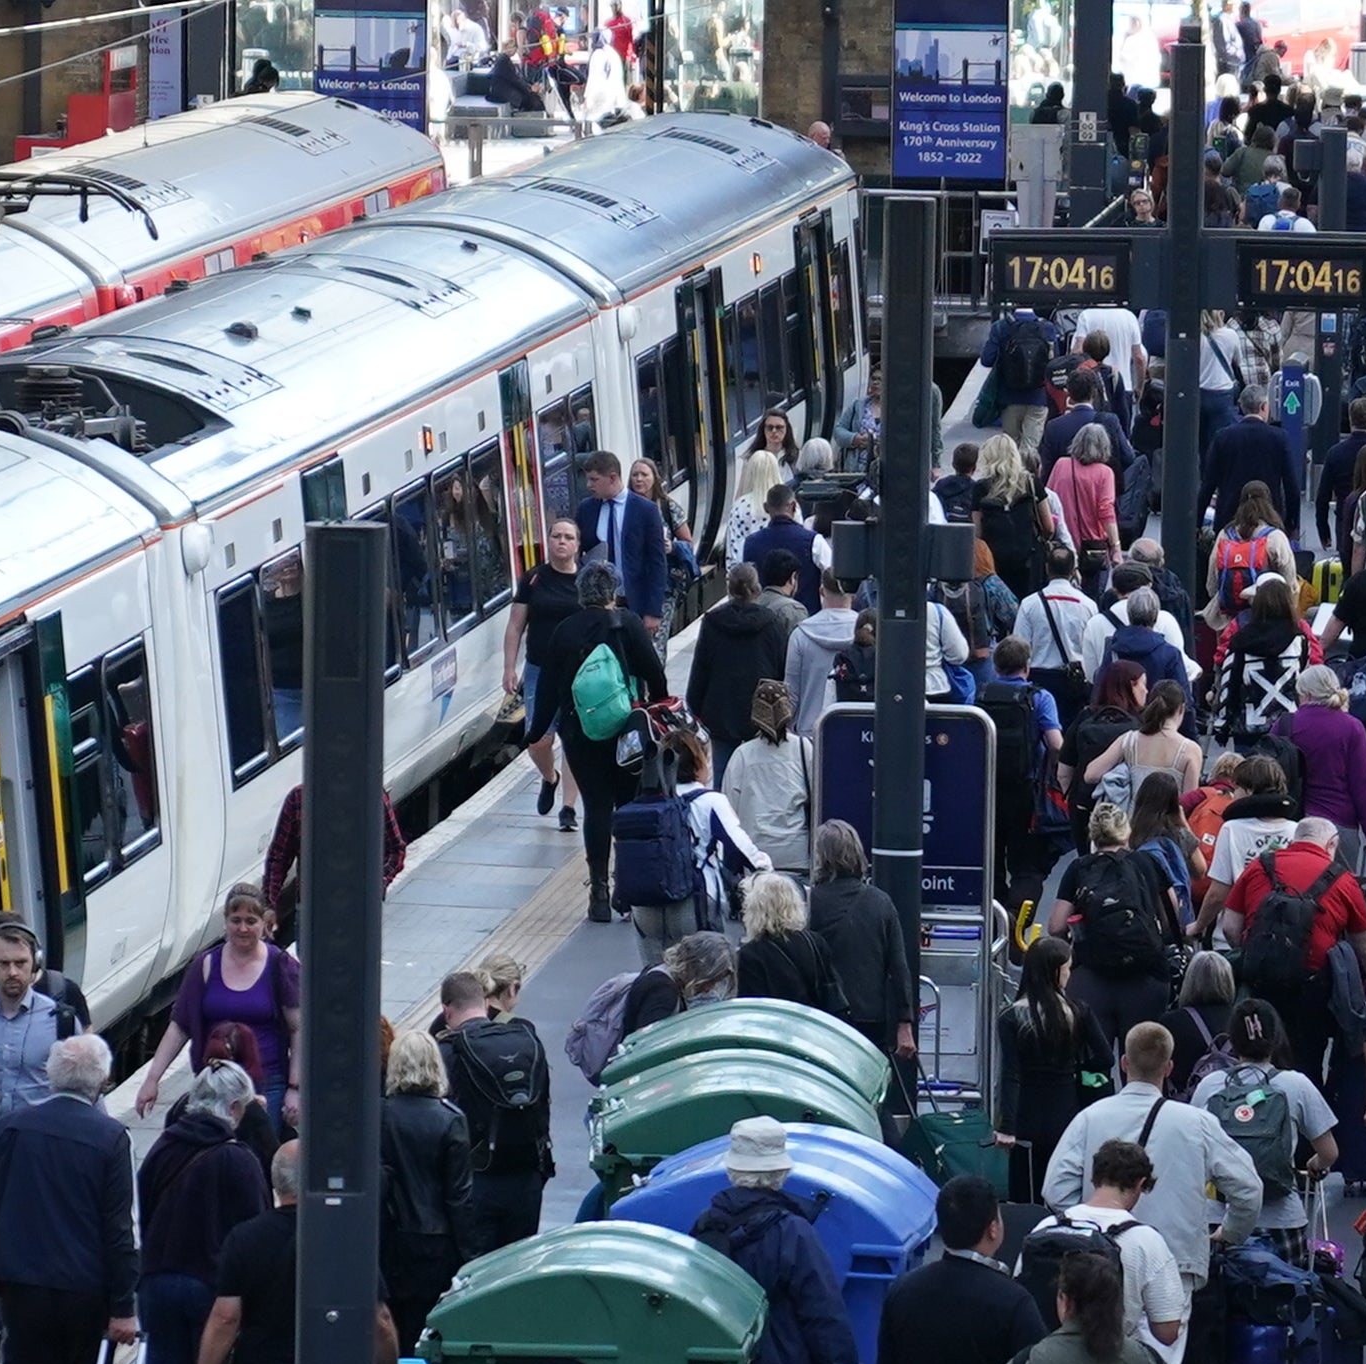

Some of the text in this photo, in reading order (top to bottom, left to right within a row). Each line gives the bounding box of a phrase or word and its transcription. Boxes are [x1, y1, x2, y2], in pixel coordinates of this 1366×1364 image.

[381, 80, 420, 91] London
[899, 92, 1002, 104] Welcome to London
[381, 108, 419, 121] Station
[899, 121, 1001, 134] King's Cross Station
[903, 135, 997, 151] 170th Anniversary
[917, 152, 944, 163] 1852
[955, 153, 982, 163] 2022
[921, 875, 955, 892] oint
